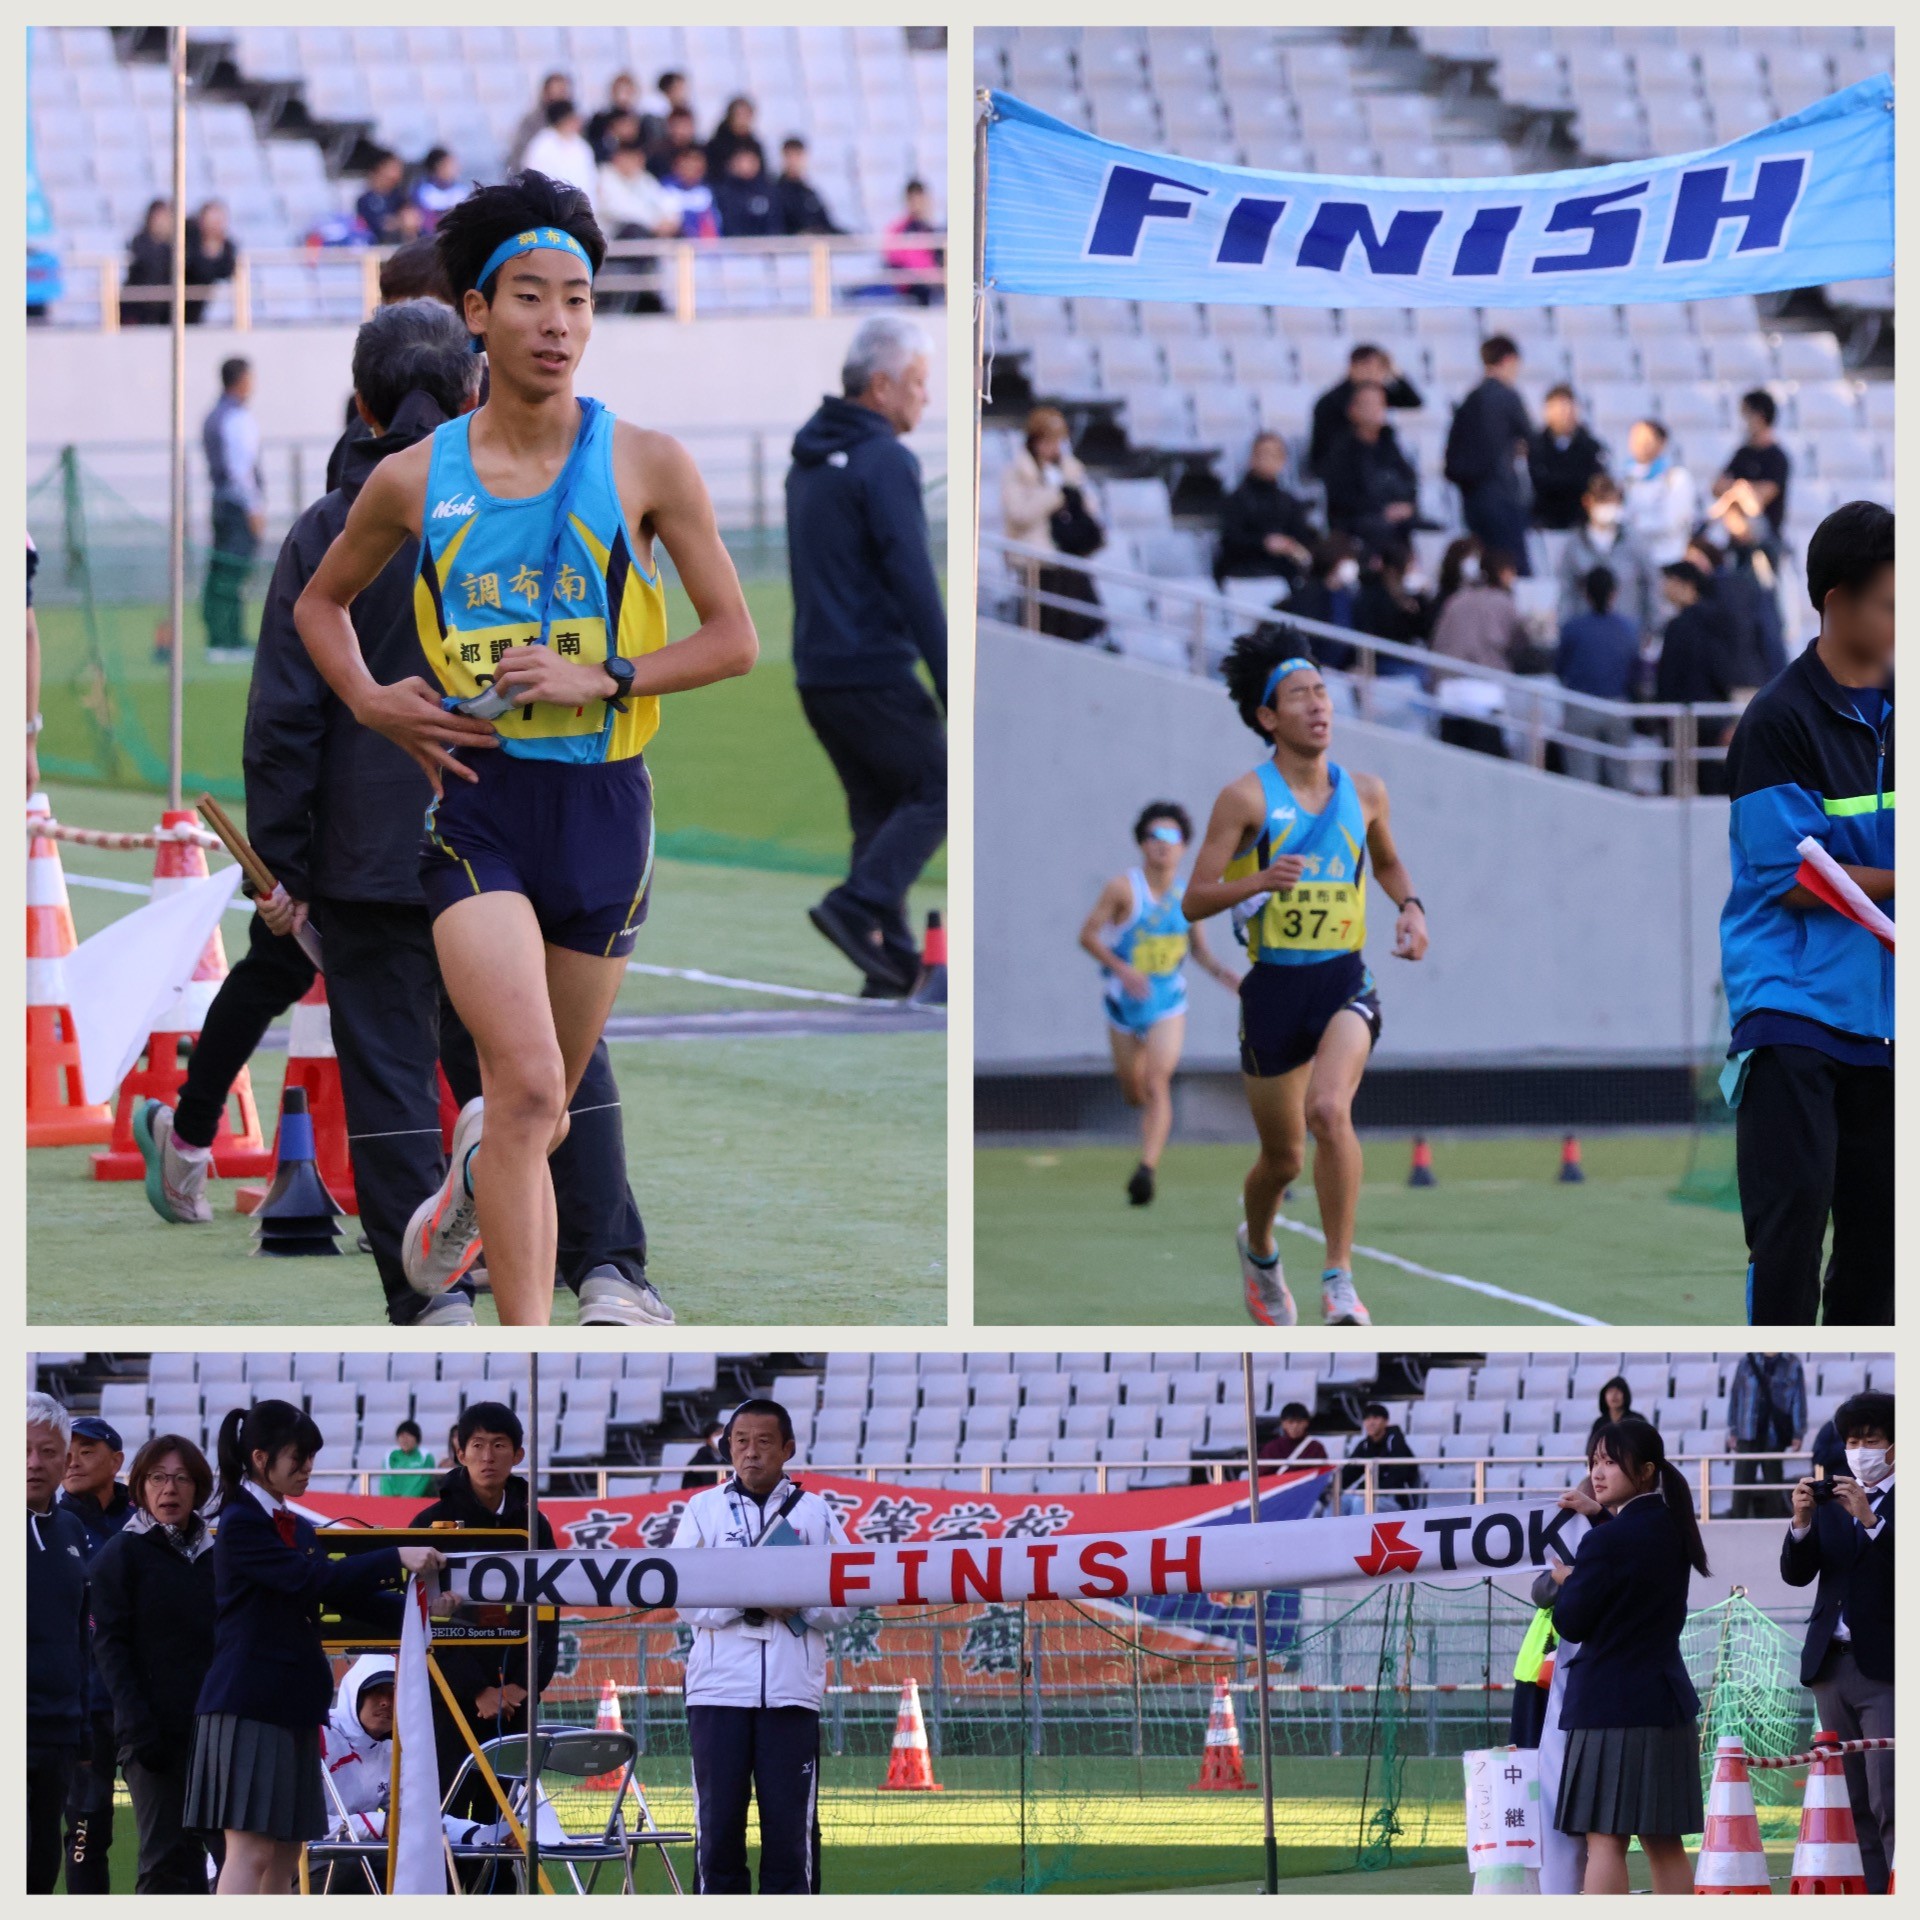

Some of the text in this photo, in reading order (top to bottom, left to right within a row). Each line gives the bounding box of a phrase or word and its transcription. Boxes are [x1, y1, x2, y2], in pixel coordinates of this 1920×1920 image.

[1084, 154, 1809, 277] FINISH
[460, 563, 587, 610] 調布南
[1283, 909, 1352, 939] 37-7
[440, 1557, 678, 1608] TOKYO
[829, 1535, 1202, 1607] FINISH
[431, 1627, 521, 1638] SEIKO Sports Timer
[1504, 1764, 1525, 1828] 中継
